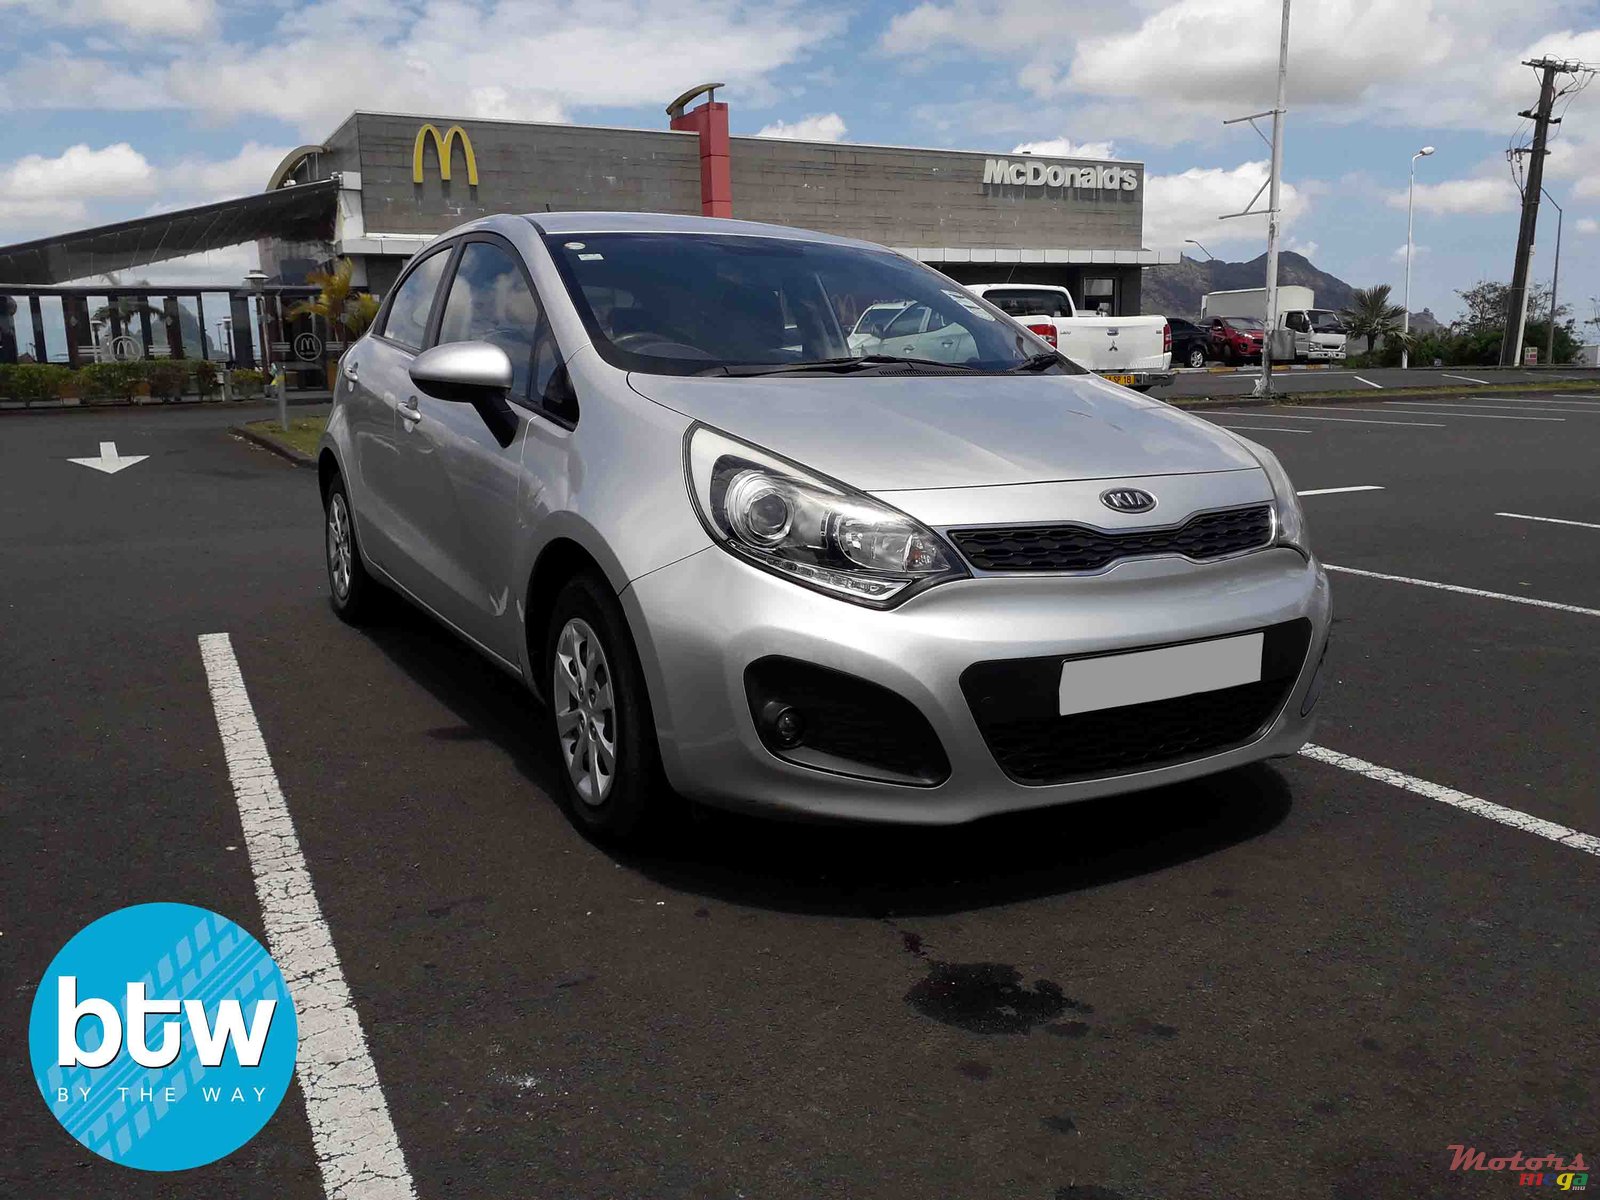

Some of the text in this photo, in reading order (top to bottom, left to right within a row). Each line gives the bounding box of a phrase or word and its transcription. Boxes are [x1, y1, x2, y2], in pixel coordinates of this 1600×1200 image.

[983, 159, 1138, 191] McDonald's
[1123, 375, 1132, 384] 18
[1109, 492, 1151, 507] KIA
